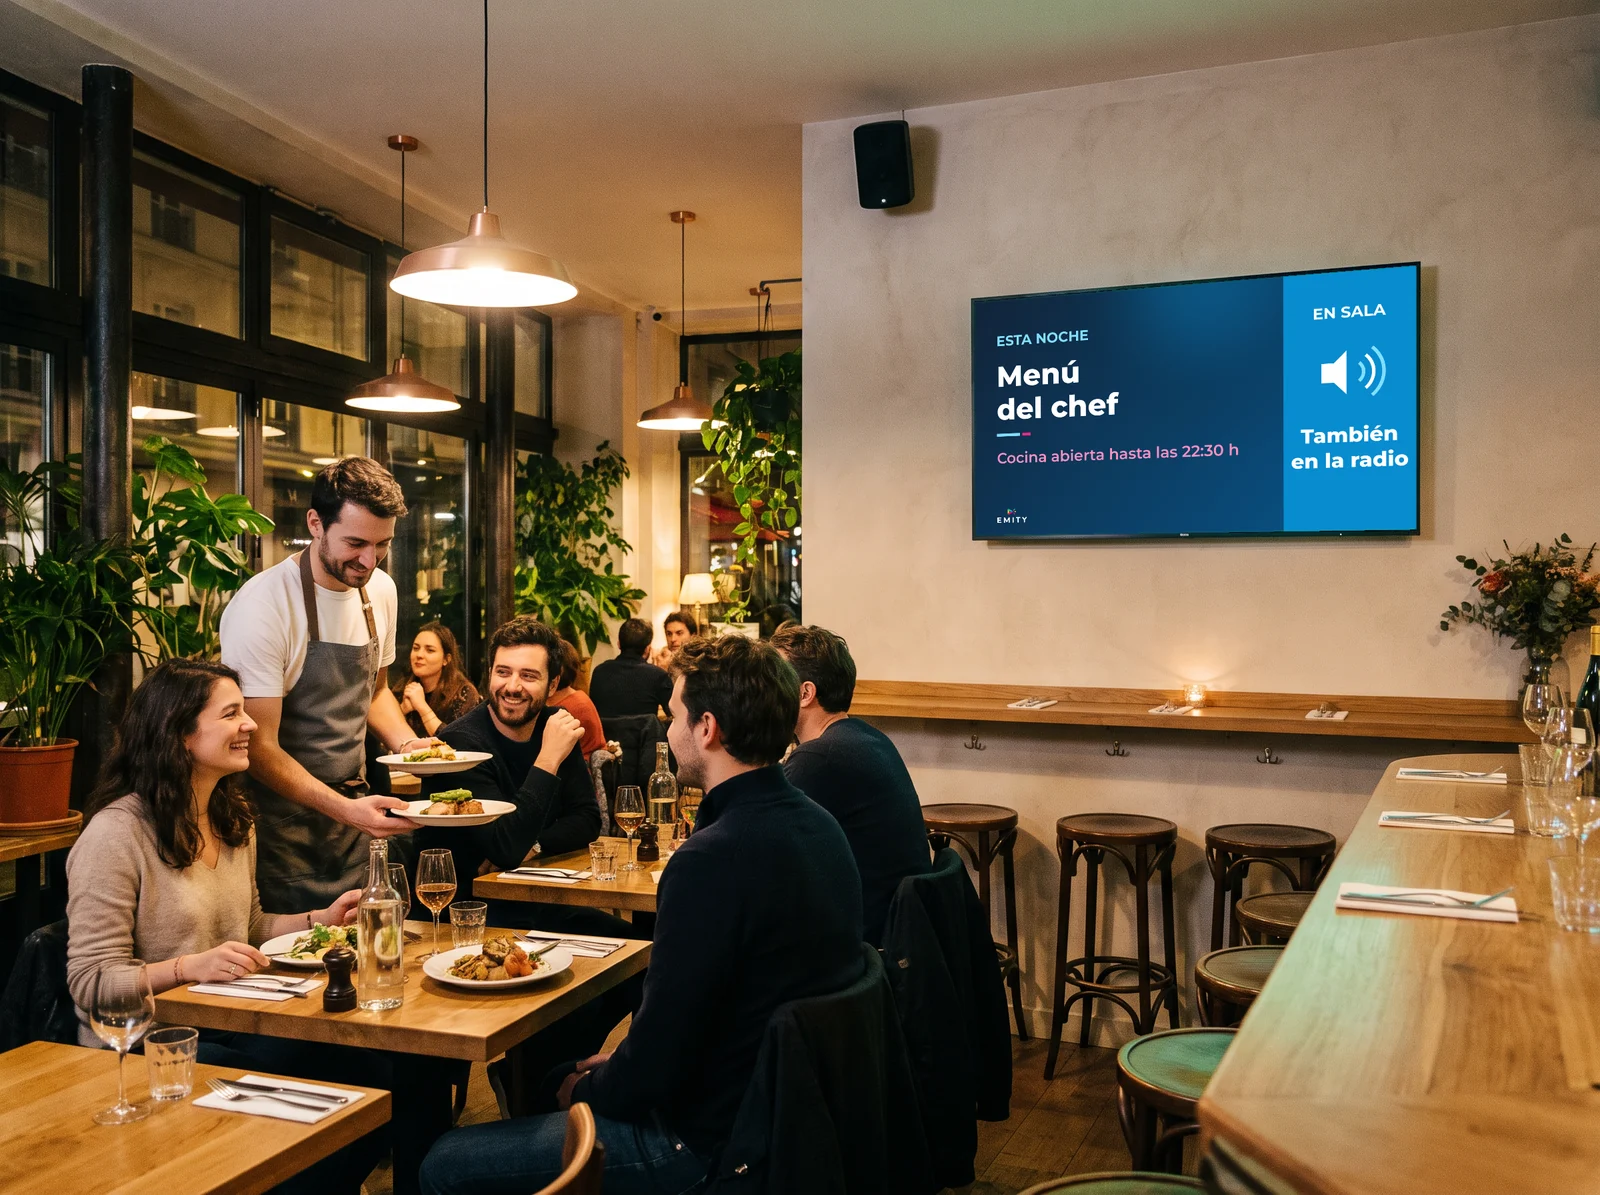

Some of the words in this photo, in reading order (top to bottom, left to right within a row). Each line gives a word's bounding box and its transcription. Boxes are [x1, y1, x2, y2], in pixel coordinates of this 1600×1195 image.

[1314, 307, 1335, 320] EN
[1341, 304, 1386, 318] SALA
[997, 334, 1032, 346] ESTA
[1037, 330, 1088, 344] NOCHE
[997, 360, 1079, 387] Menú
[997, 396, 1041, 420] del
[1051, 392, 1119, 418] chef
[1300, 425, 1398, 444] También
[997, 450, 1046, 464] Cocina
[1052, 449, 1104, 462] abierta
[1110, 446, 1151, 460] hasta
[1157, 446, 1177, 458] las
[1182, 444, 1223, 457] 22:30
[1229, 442, 1239, 457] h
[1291, 457, 1318, 469] en
[1326, 452, 1343, 468] la
[1351, 449, 1409, 468] radio
[996, 516, 1028, 524] EMITY
